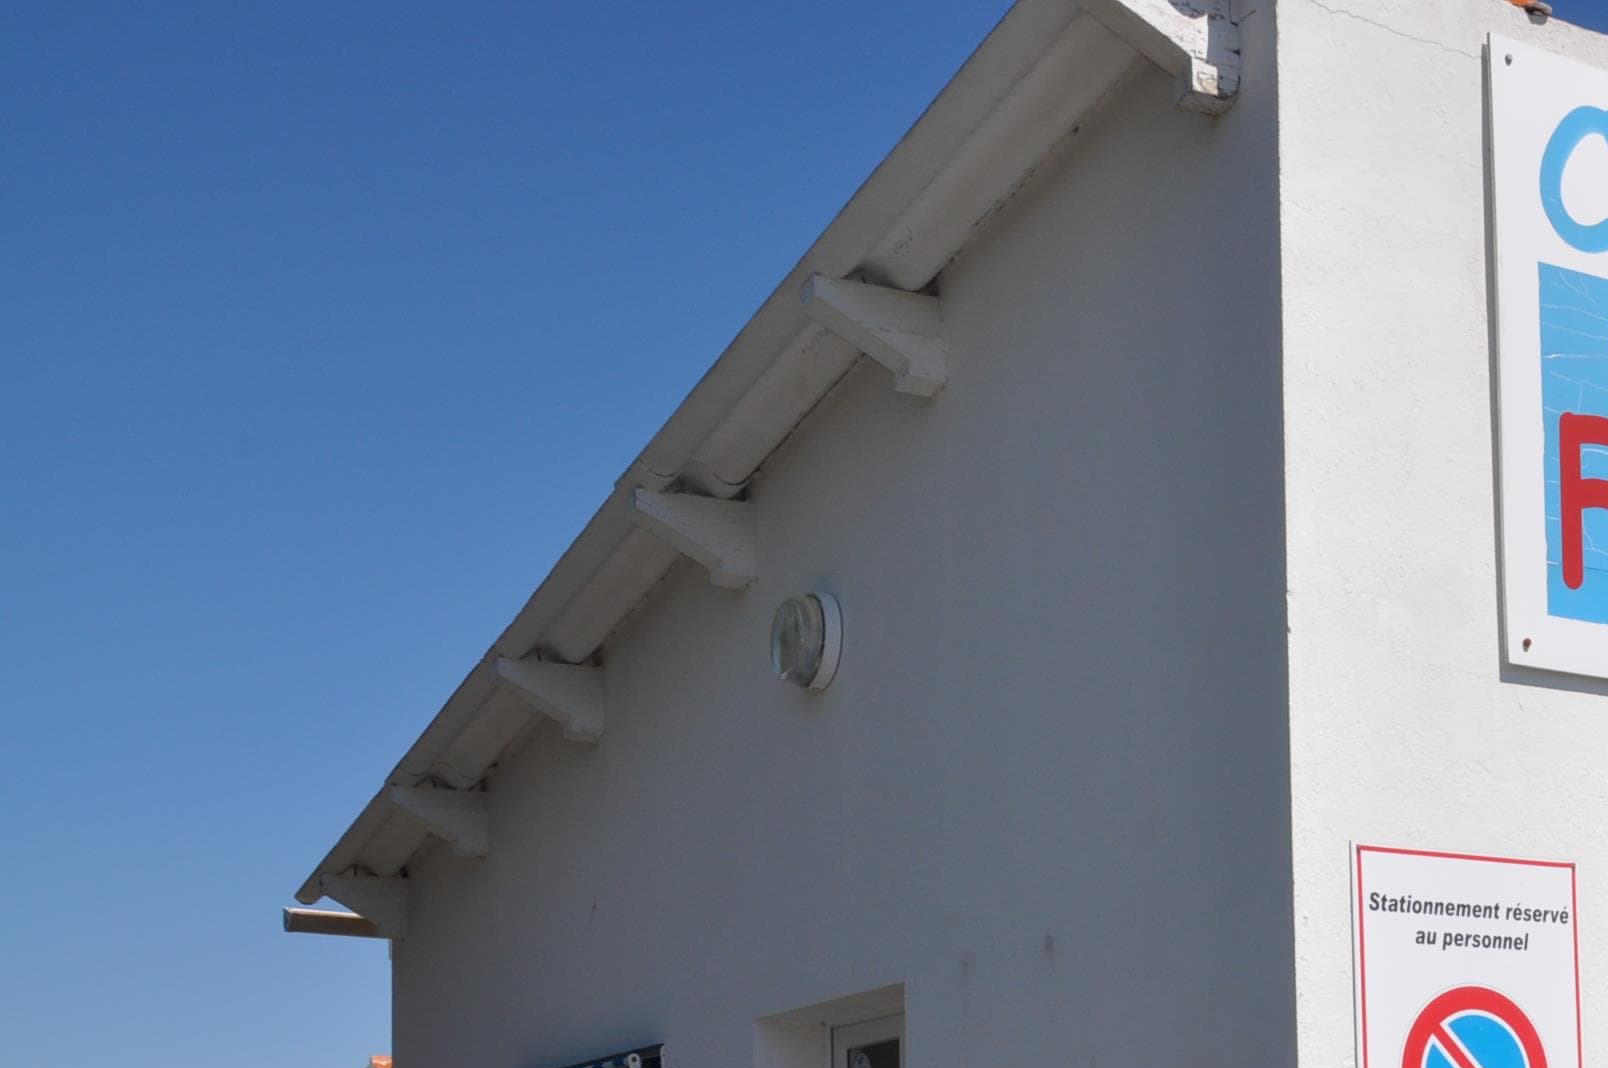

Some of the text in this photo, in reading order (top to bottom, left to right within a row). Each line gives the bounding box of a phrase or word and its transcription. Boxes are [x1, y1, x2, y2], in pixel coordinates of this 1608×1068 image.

[1369, 892, 1569, 924] Stationnement réservé
[1415, 930, 1529, 951] au personnel
